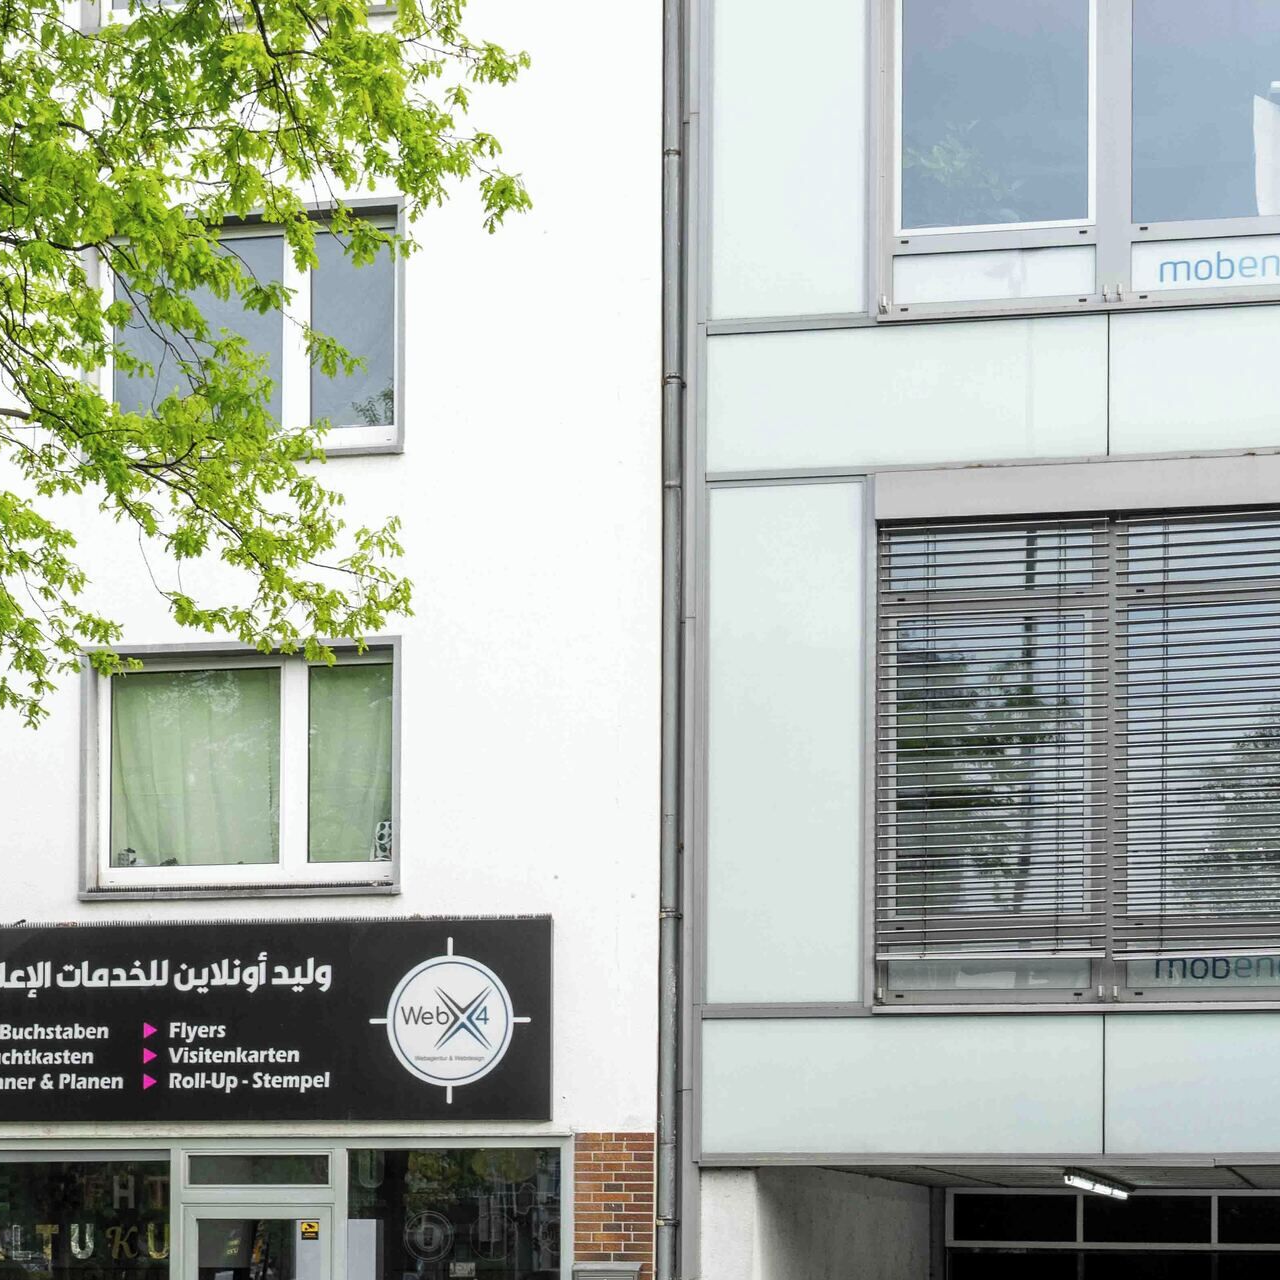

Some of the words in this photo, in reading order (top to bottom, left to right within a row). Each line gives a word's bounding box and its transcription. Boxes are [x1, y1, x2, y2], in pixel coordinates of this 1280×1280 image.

[56, 959, 169, 989] للخدمات
[174, 951, 268, 994] أونلاين
[271, 957, 333, 993] وليد
[0, 1023, 110, 1041] Buchstaben
[169, 1021, 226, 1042] Flyers
[169, 1047, 300, 1064] Visitenkarten
[39, 1073, 54, 1090] &
[58, 1072, 124, 1090] Planen
[169, 1072, 238, 1092] Roll-Up
[252, 1071, 331, 1092] Stempel
